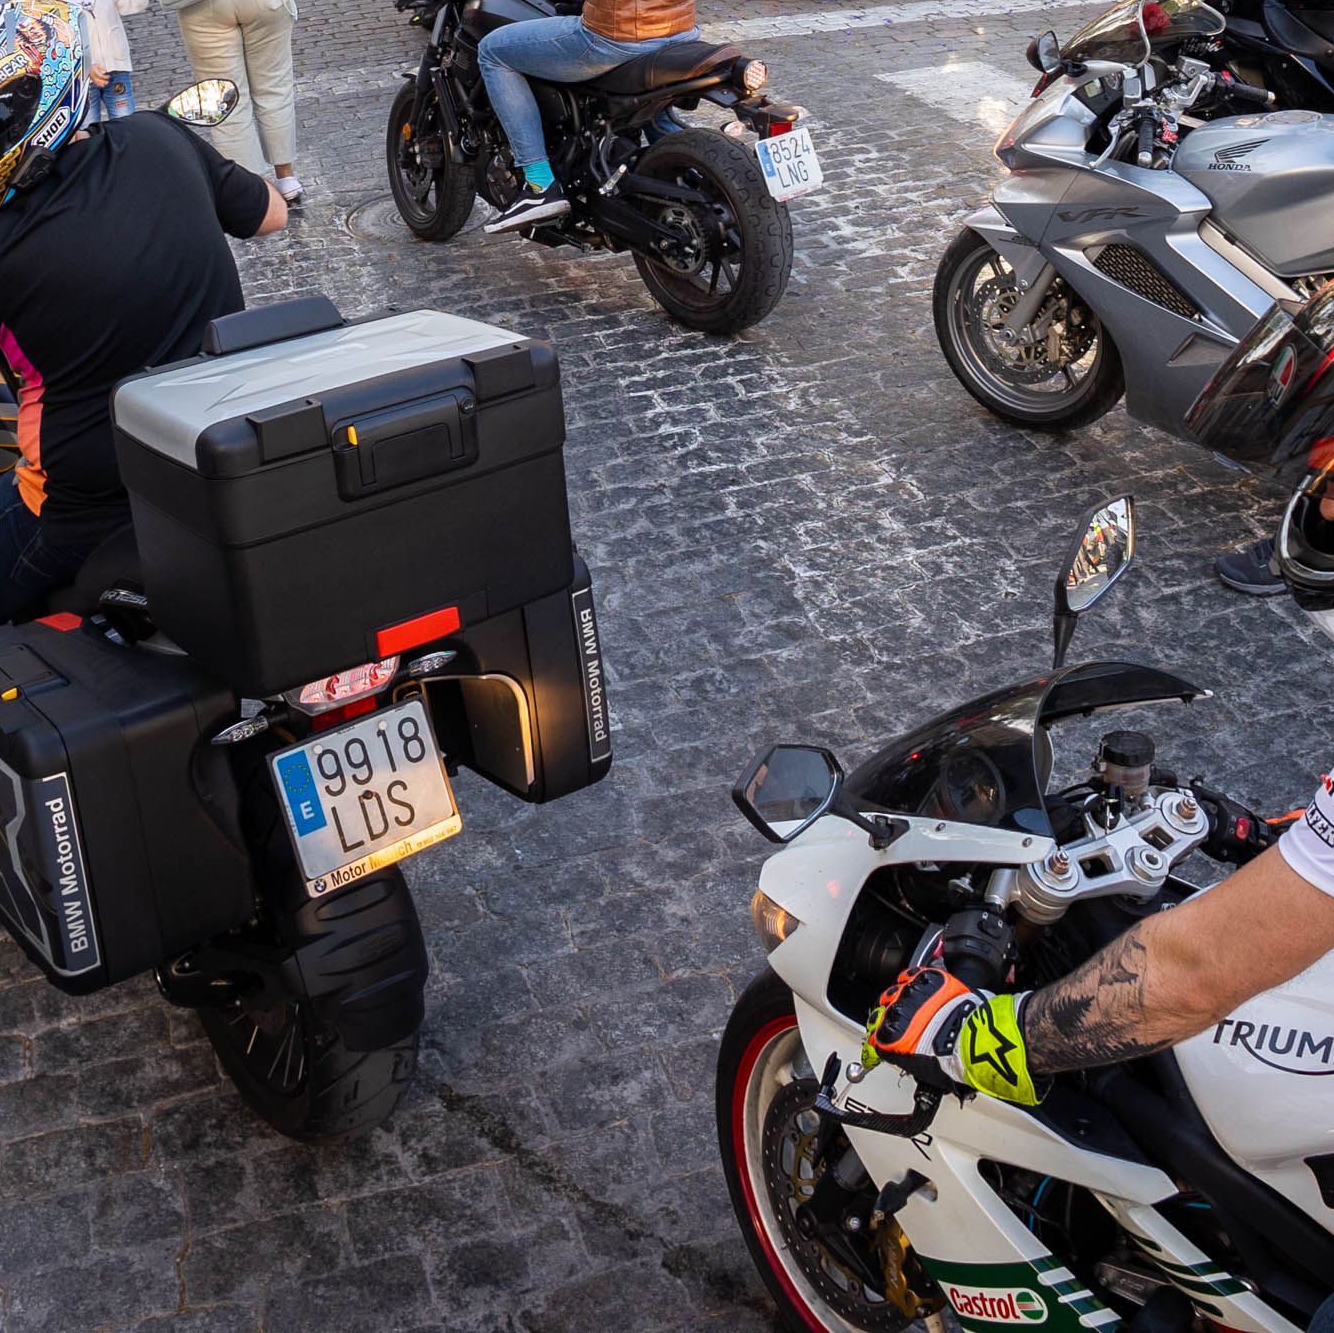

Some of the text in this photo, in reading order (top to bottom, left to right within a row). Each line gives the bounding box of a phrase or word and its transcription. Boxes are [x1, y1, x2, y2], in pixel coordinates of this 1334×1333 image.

[37, 112, 67, 147] SHOEI
[770, 132, 812, 165] 8524
[778, 160, 810, 188] LNG
[1208, 162, 1256, 171] HONDA
[1059, 207, 1142, 223] VFR
[579, 608, 608, 744] BMW Motorrad
[317, 715, 428, 800] 9918
[301, 802, 315, 819] E
[331, 778, 417, 854] LDS
[45, 798, 92, 954] BMW Motorrad
[329, 860, 367, 888] Motor
[950, 1287, 1021, 1321] Castrol
